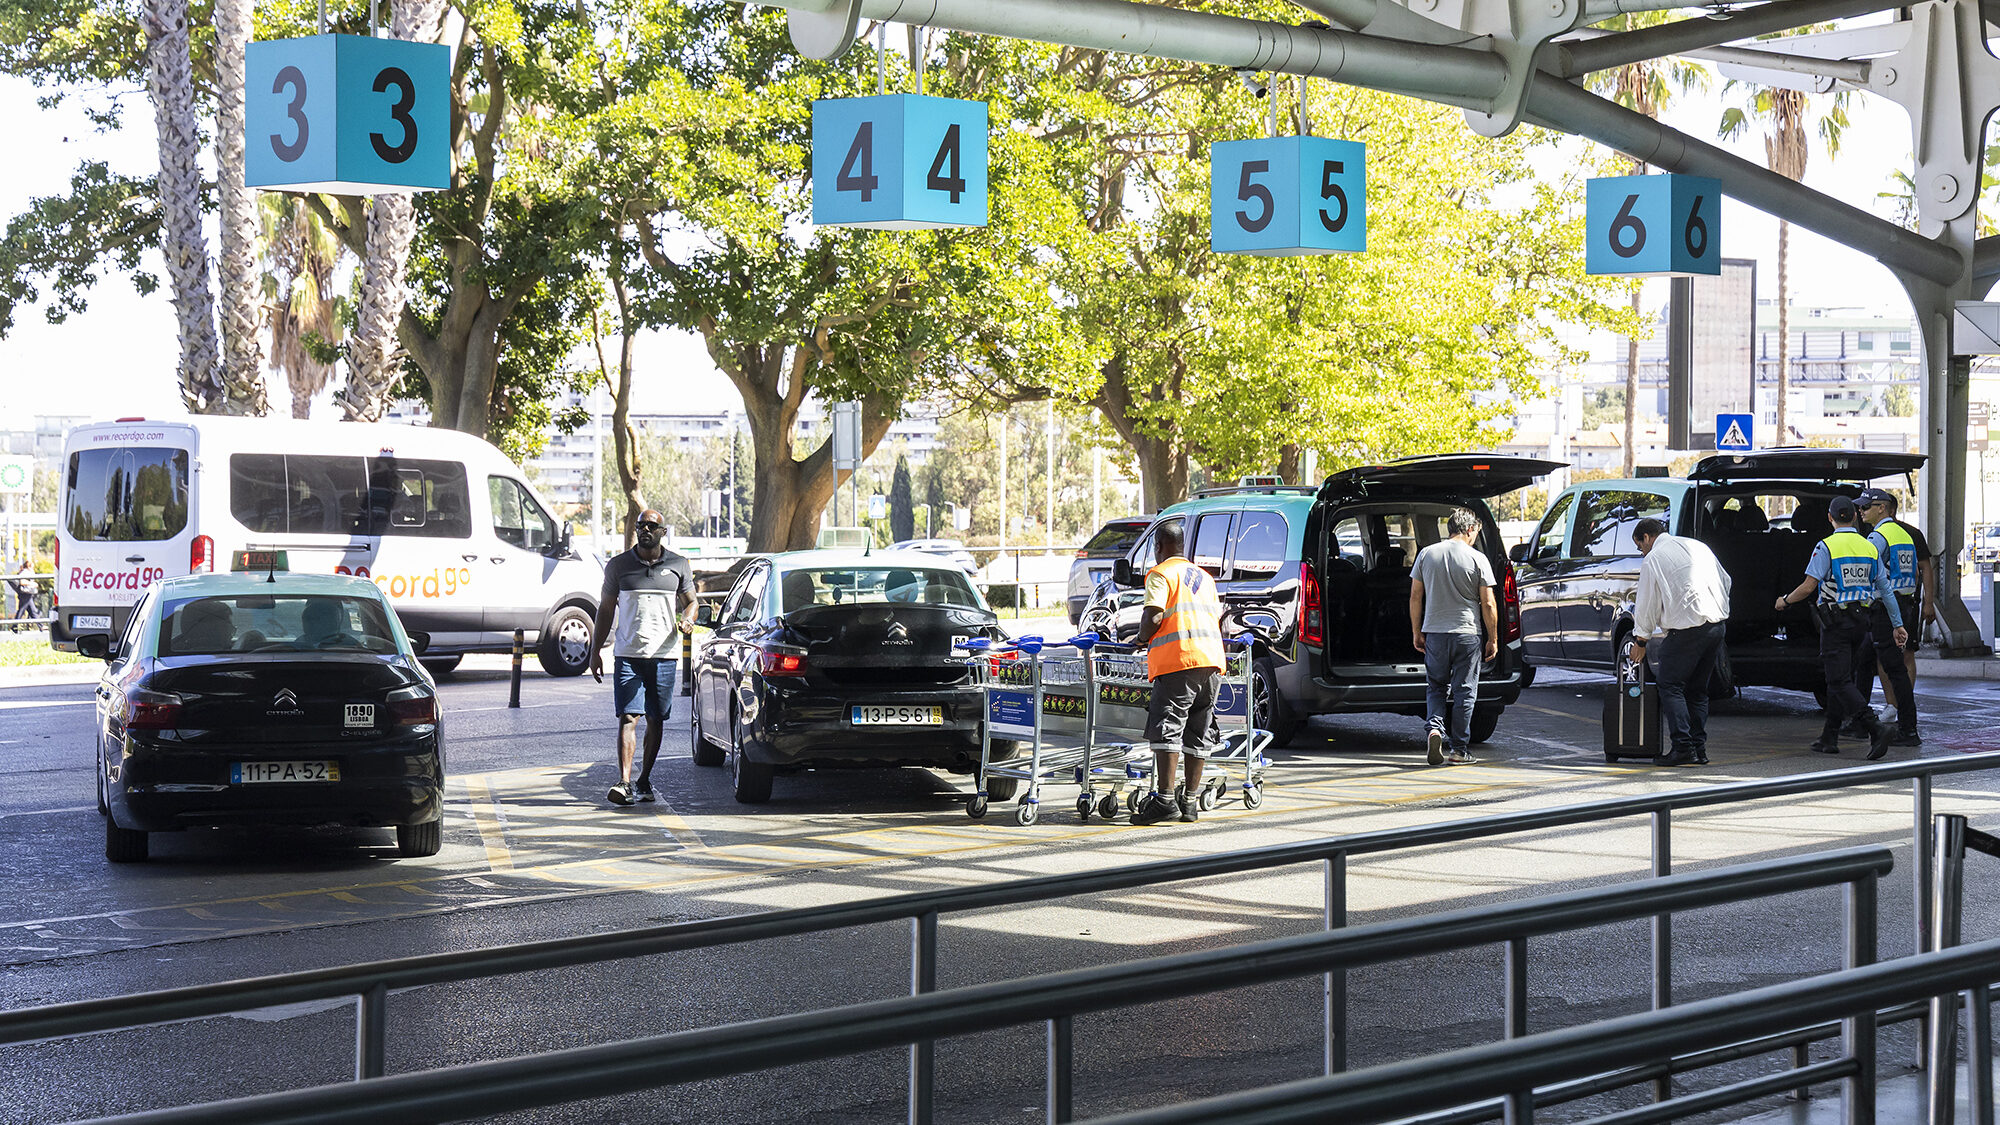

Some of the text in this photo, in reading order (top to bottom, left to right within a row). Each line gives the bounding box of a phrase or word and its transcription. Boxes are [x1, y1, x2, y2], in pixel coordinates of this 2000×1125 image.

[270, 66, 309, 163] 3
[369, 67, 418, 164] 3
[836, 122, 878, 202] 4
[926, 124, 966, 204] 4
[1235, 160, 1274, 233] 5
[1319, 160, 1348, 233] 5
[1608, 194, 1646, 258] 6
[1685, 195, 1707, 258] 6
[93, 431, 164, 442] www.recordgo.com
[250, 552, 278, 564] TAXI
[346, 705, 373, 716] 1890
